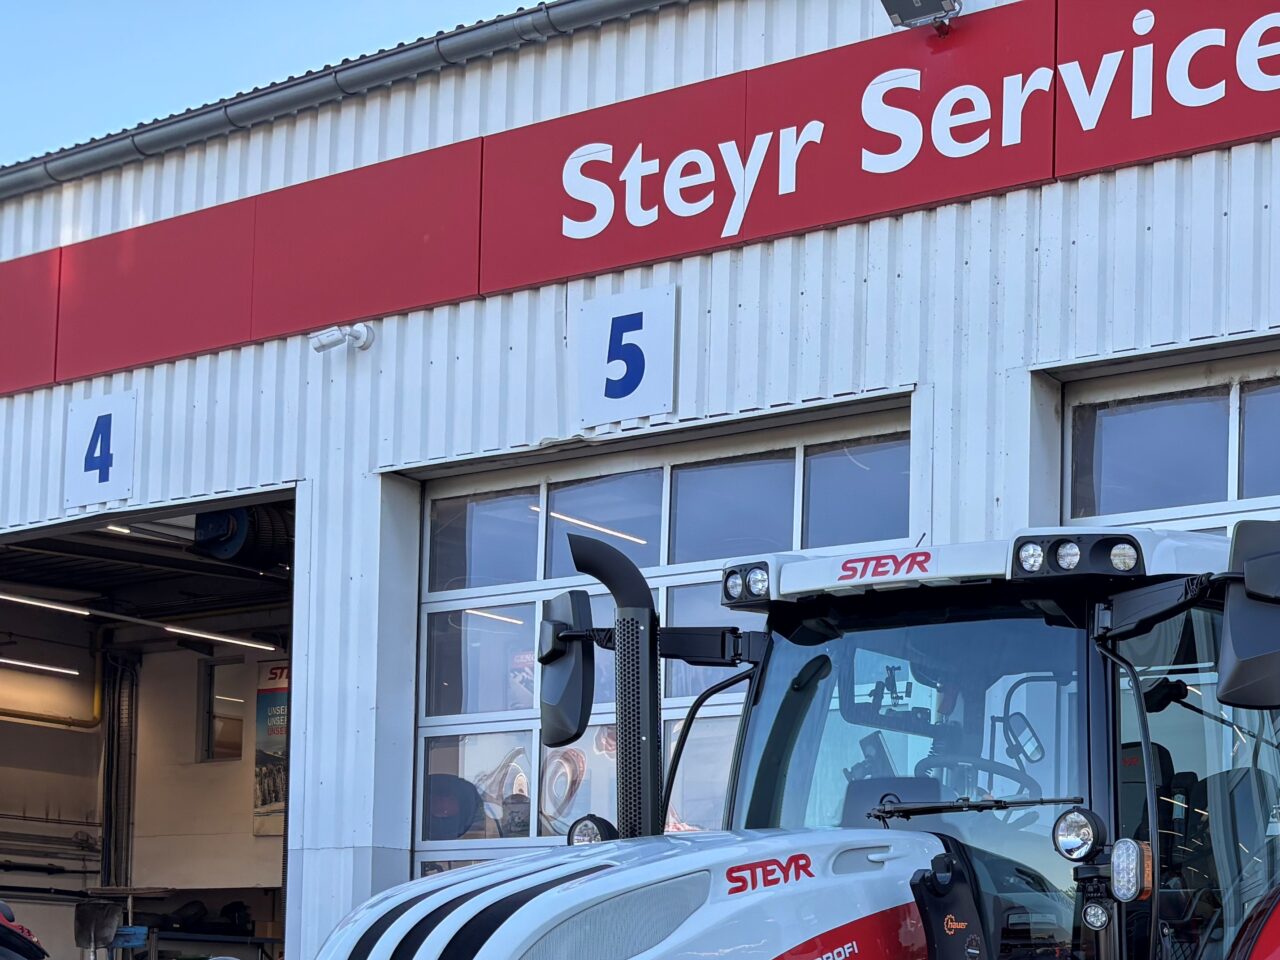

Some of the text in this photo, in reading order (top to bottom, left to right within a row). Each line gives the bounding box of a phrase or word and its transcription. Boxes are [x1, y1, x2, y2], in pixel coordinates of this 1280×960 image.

[561, 119, 825, 240] Steyr
[604, 311, 645, 399] 5
[84, 413, 113, 483] 4
[838, 551, 932, 581] STEYR
[725, 853, 816, 895] STEYR
